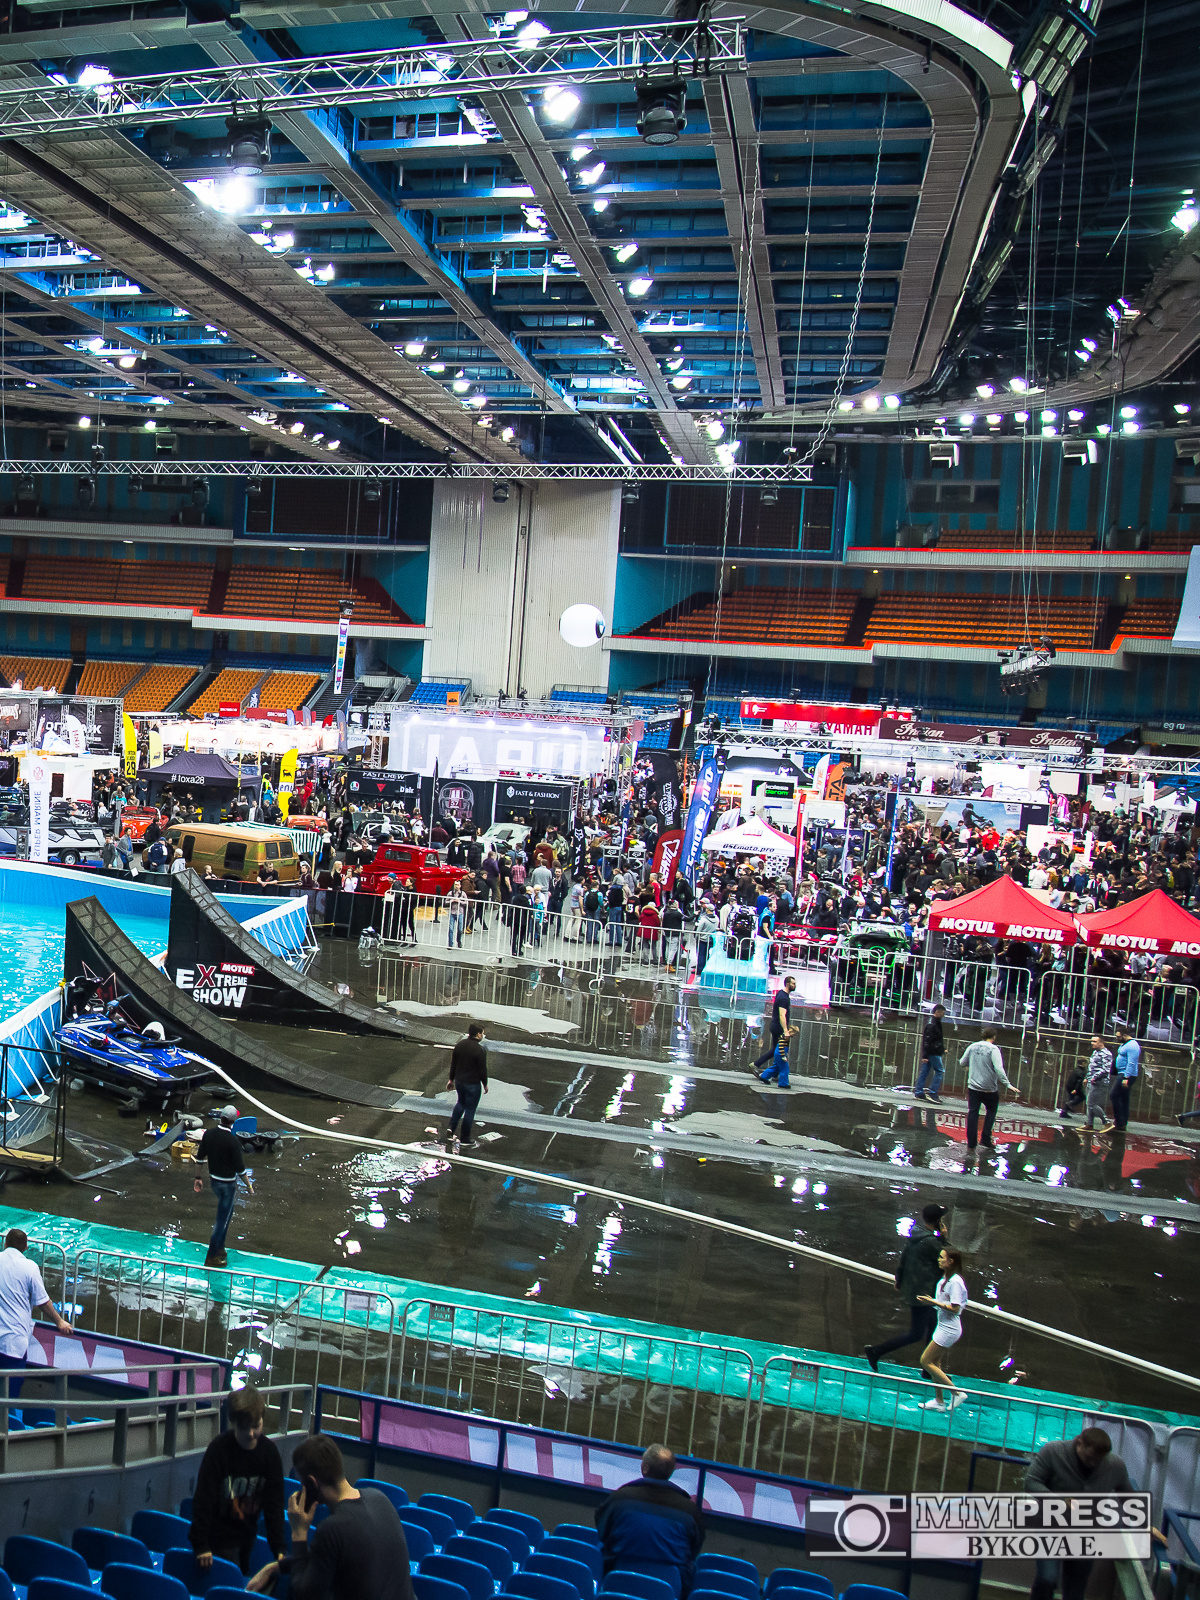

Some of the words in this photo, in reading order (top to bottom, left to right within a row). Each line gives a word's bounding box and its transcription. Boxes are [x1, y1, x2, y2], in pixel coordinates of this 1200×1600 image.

[827, 722, 873, 736] YAMAH
[894, 722, 945, 738] Inian
[534, 791, 560, 799] FASHION
[939, 917, 996, 935] MOTUL
[1006, 924, 1065, 942] MOTUL
[1099, 933, 1160, 951] MOTUL
[175, 963, 248, 990] EXTREME
[221, 963, 255, 975] MOTUL
[192, 986, 247, 1009] SHOW
